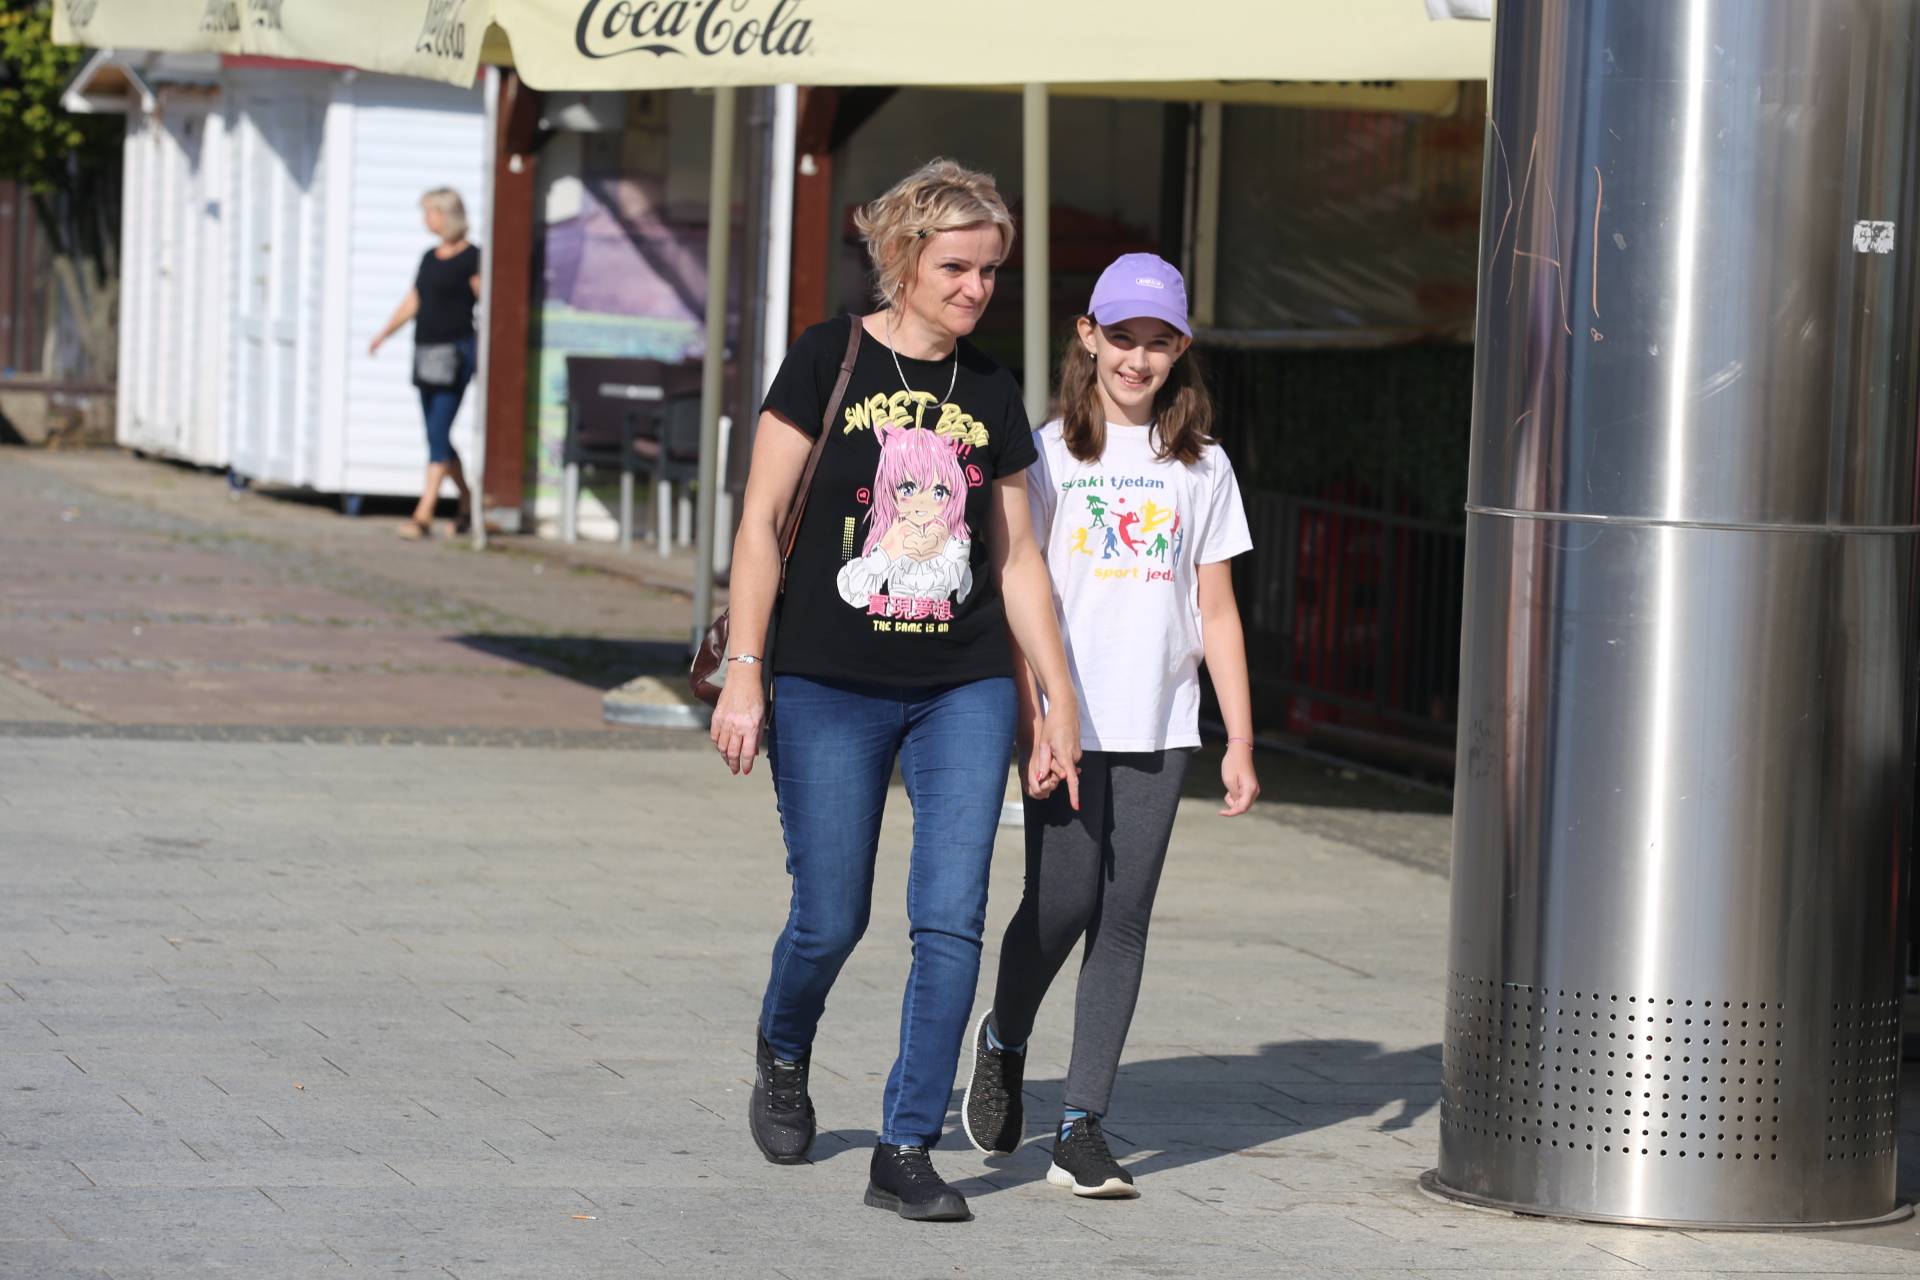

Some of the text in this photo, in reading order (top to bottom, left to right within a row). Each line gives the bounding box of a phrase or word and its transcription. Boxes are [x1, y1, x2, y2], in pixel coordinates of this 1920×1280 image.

[843, 390, 939, 436] SWEET
[1110, 476, 1165, 490] tjedan
[1094, 567, 1139, 580] sport
[873, 620, 891, 632] THE
[895, 622, 922, 633] GAME
